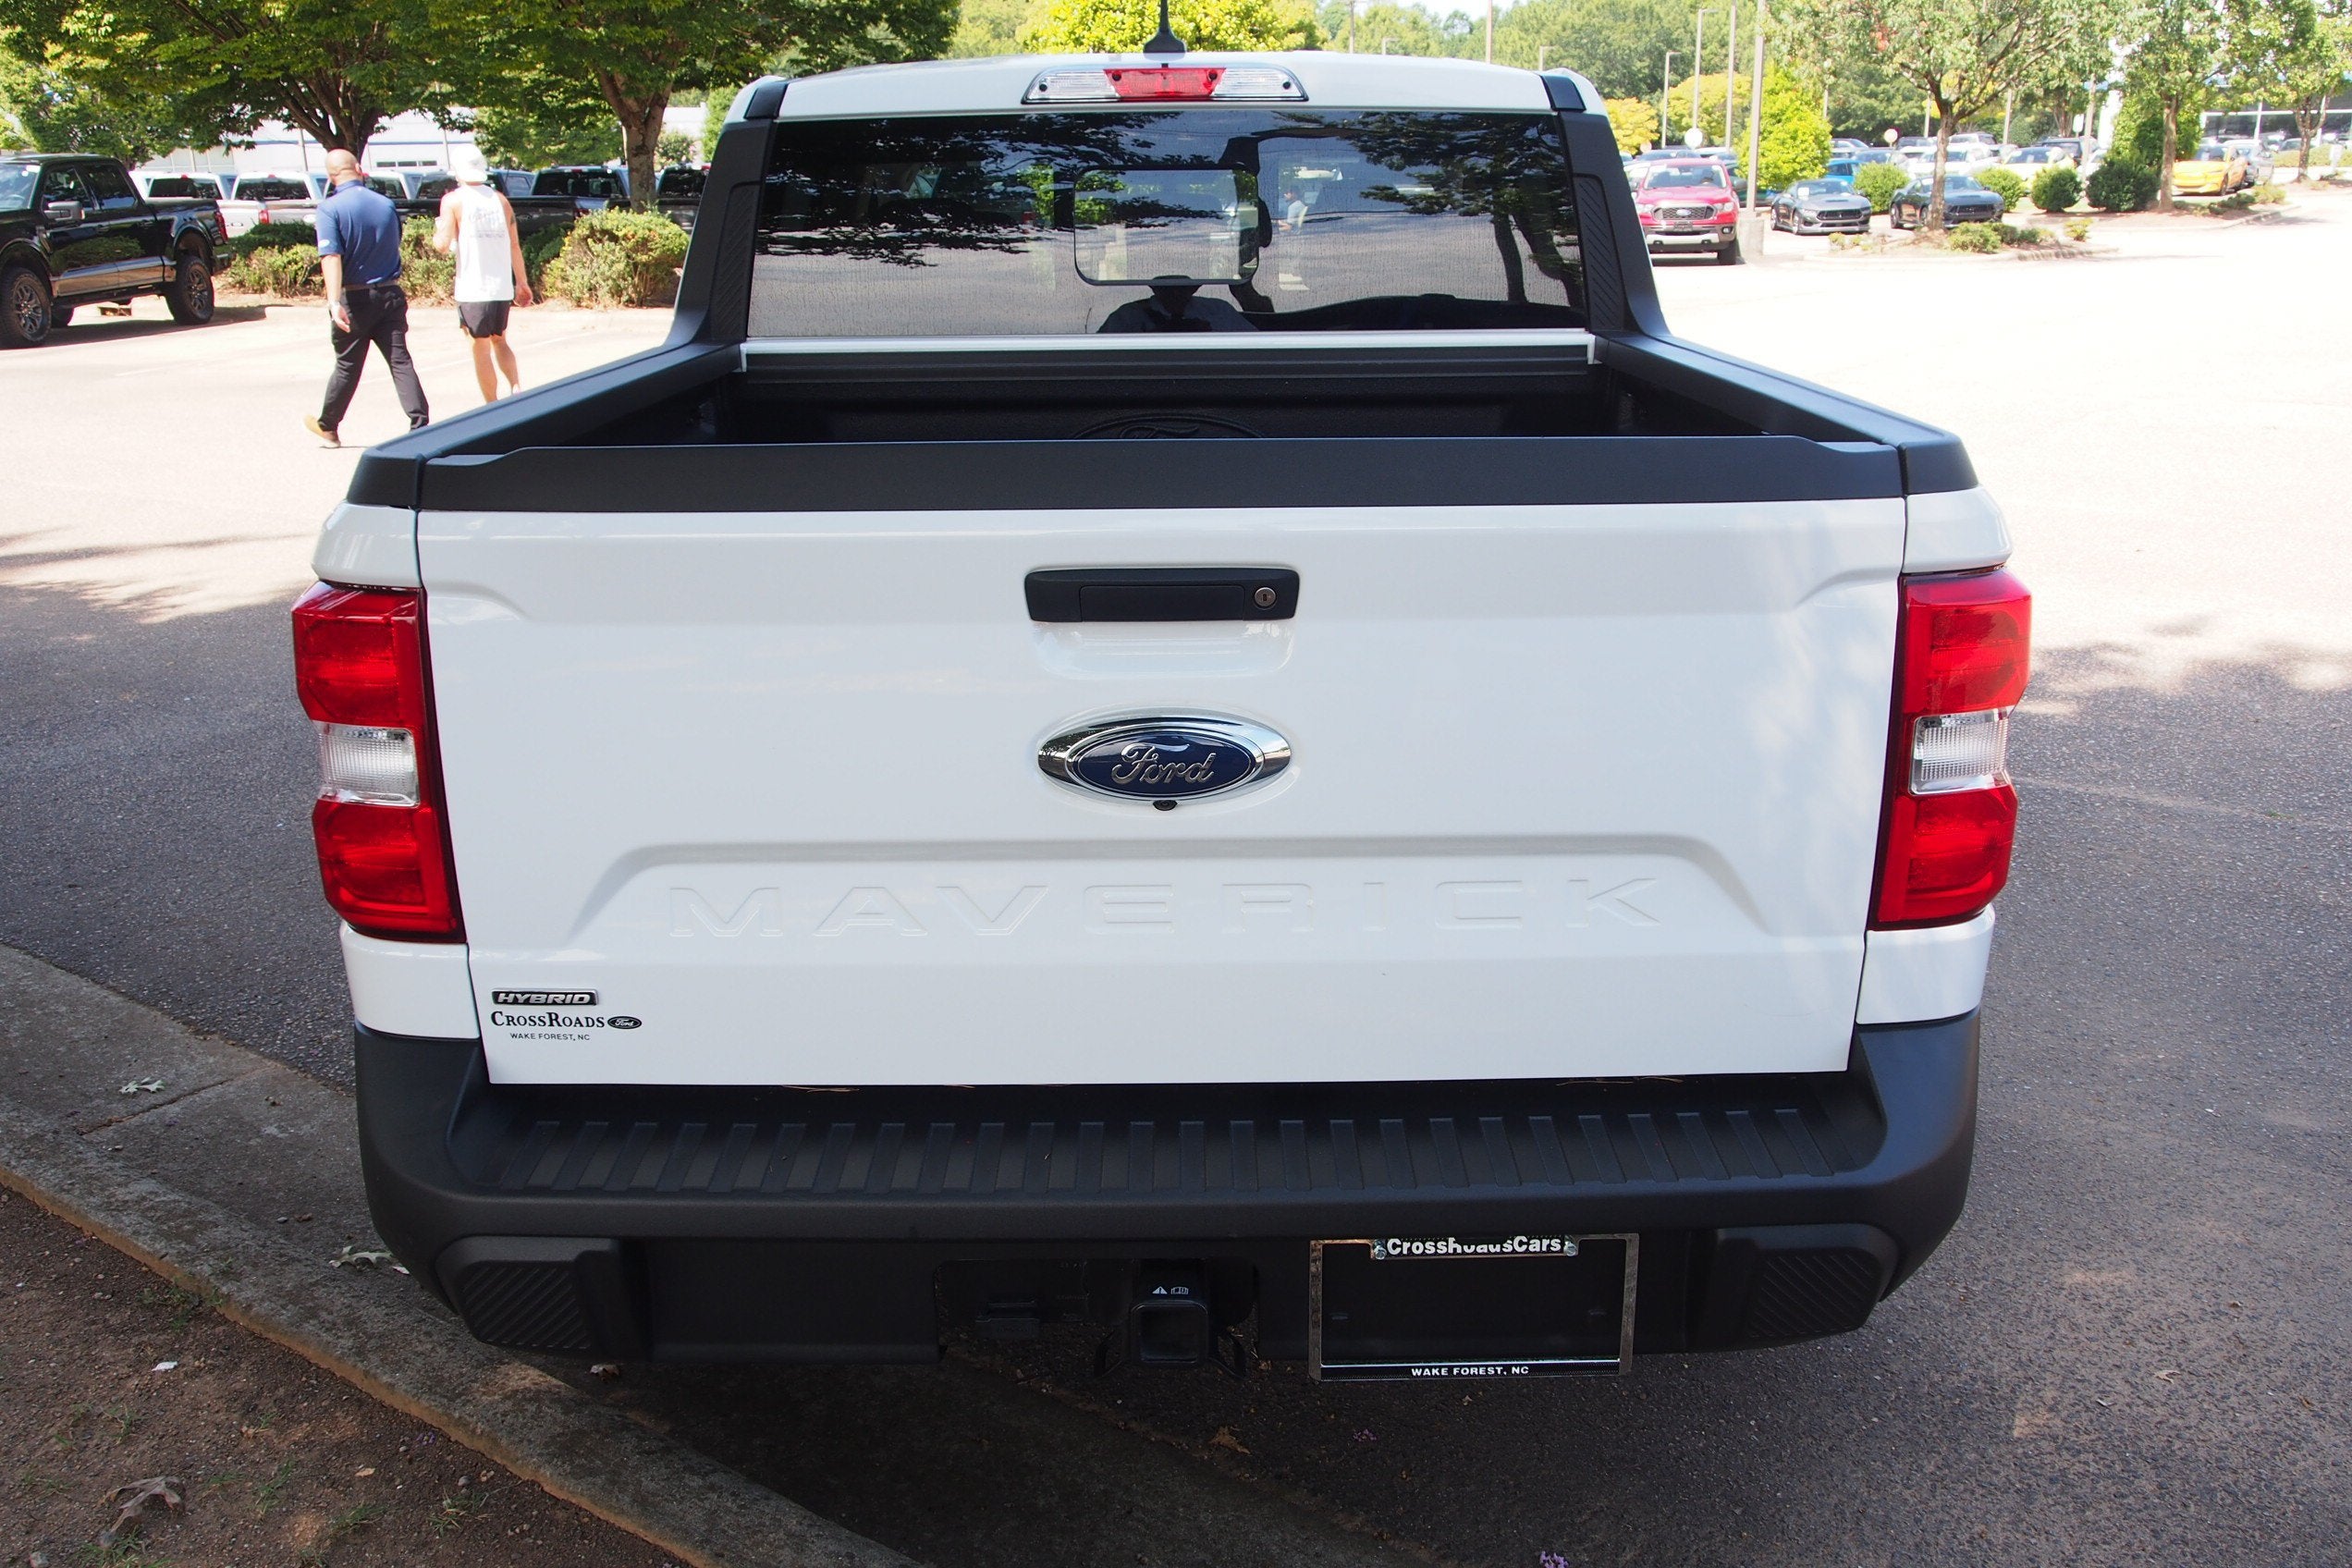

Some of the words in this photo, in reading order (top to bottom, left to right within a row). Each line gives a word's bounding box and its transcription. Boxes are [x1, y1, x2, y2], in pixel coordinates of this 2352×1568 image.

[1111, 741, 1217, 785] Ford
[669, 877, 1662, 937] MAVERICK
[496, 992, 592, 1005] HYBRID
[509, 1032, 535, 1040] WAKE
[538, 1033, 576, 1041] FOREST,
[1411, 1367, 1449, 1377] WAKE
[1452, 1366, 1507, 1376] FOREST,
[1511, 1366, 1529, 1375] NC
